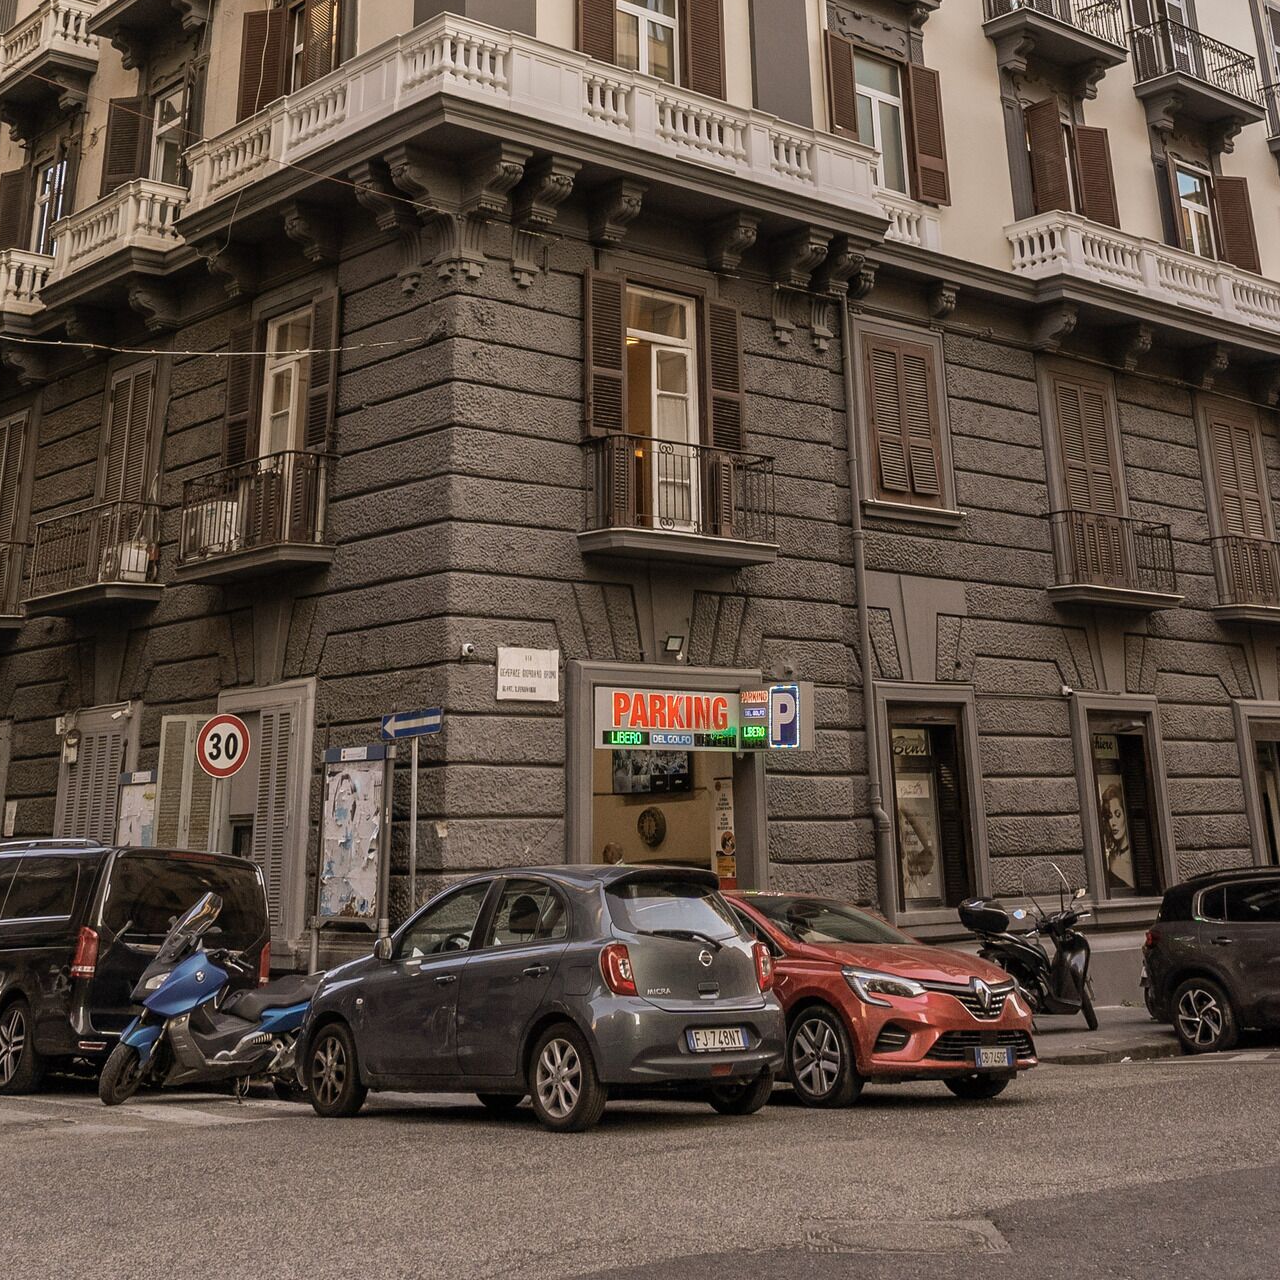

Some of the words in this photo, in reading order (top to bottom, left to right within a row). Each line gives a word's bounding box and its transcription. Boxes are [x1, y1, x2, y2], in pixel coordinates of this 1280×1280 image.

[740, 690, 768, 703] PARKING
[612, 691, 728, 730] PARKING
[772, 692, 795, 741] P
[611, 732, 642, 744] LIBERO
[743, 727, 765, 738] LIBERO
[209, 732, 238, 760] 30
[653, 734, 666, 744] DEL
[667, 735, 692, 745] GOLFO
[647, 987, 671, 996] MICRA
[694, 1030, 708, 1048] FJ
